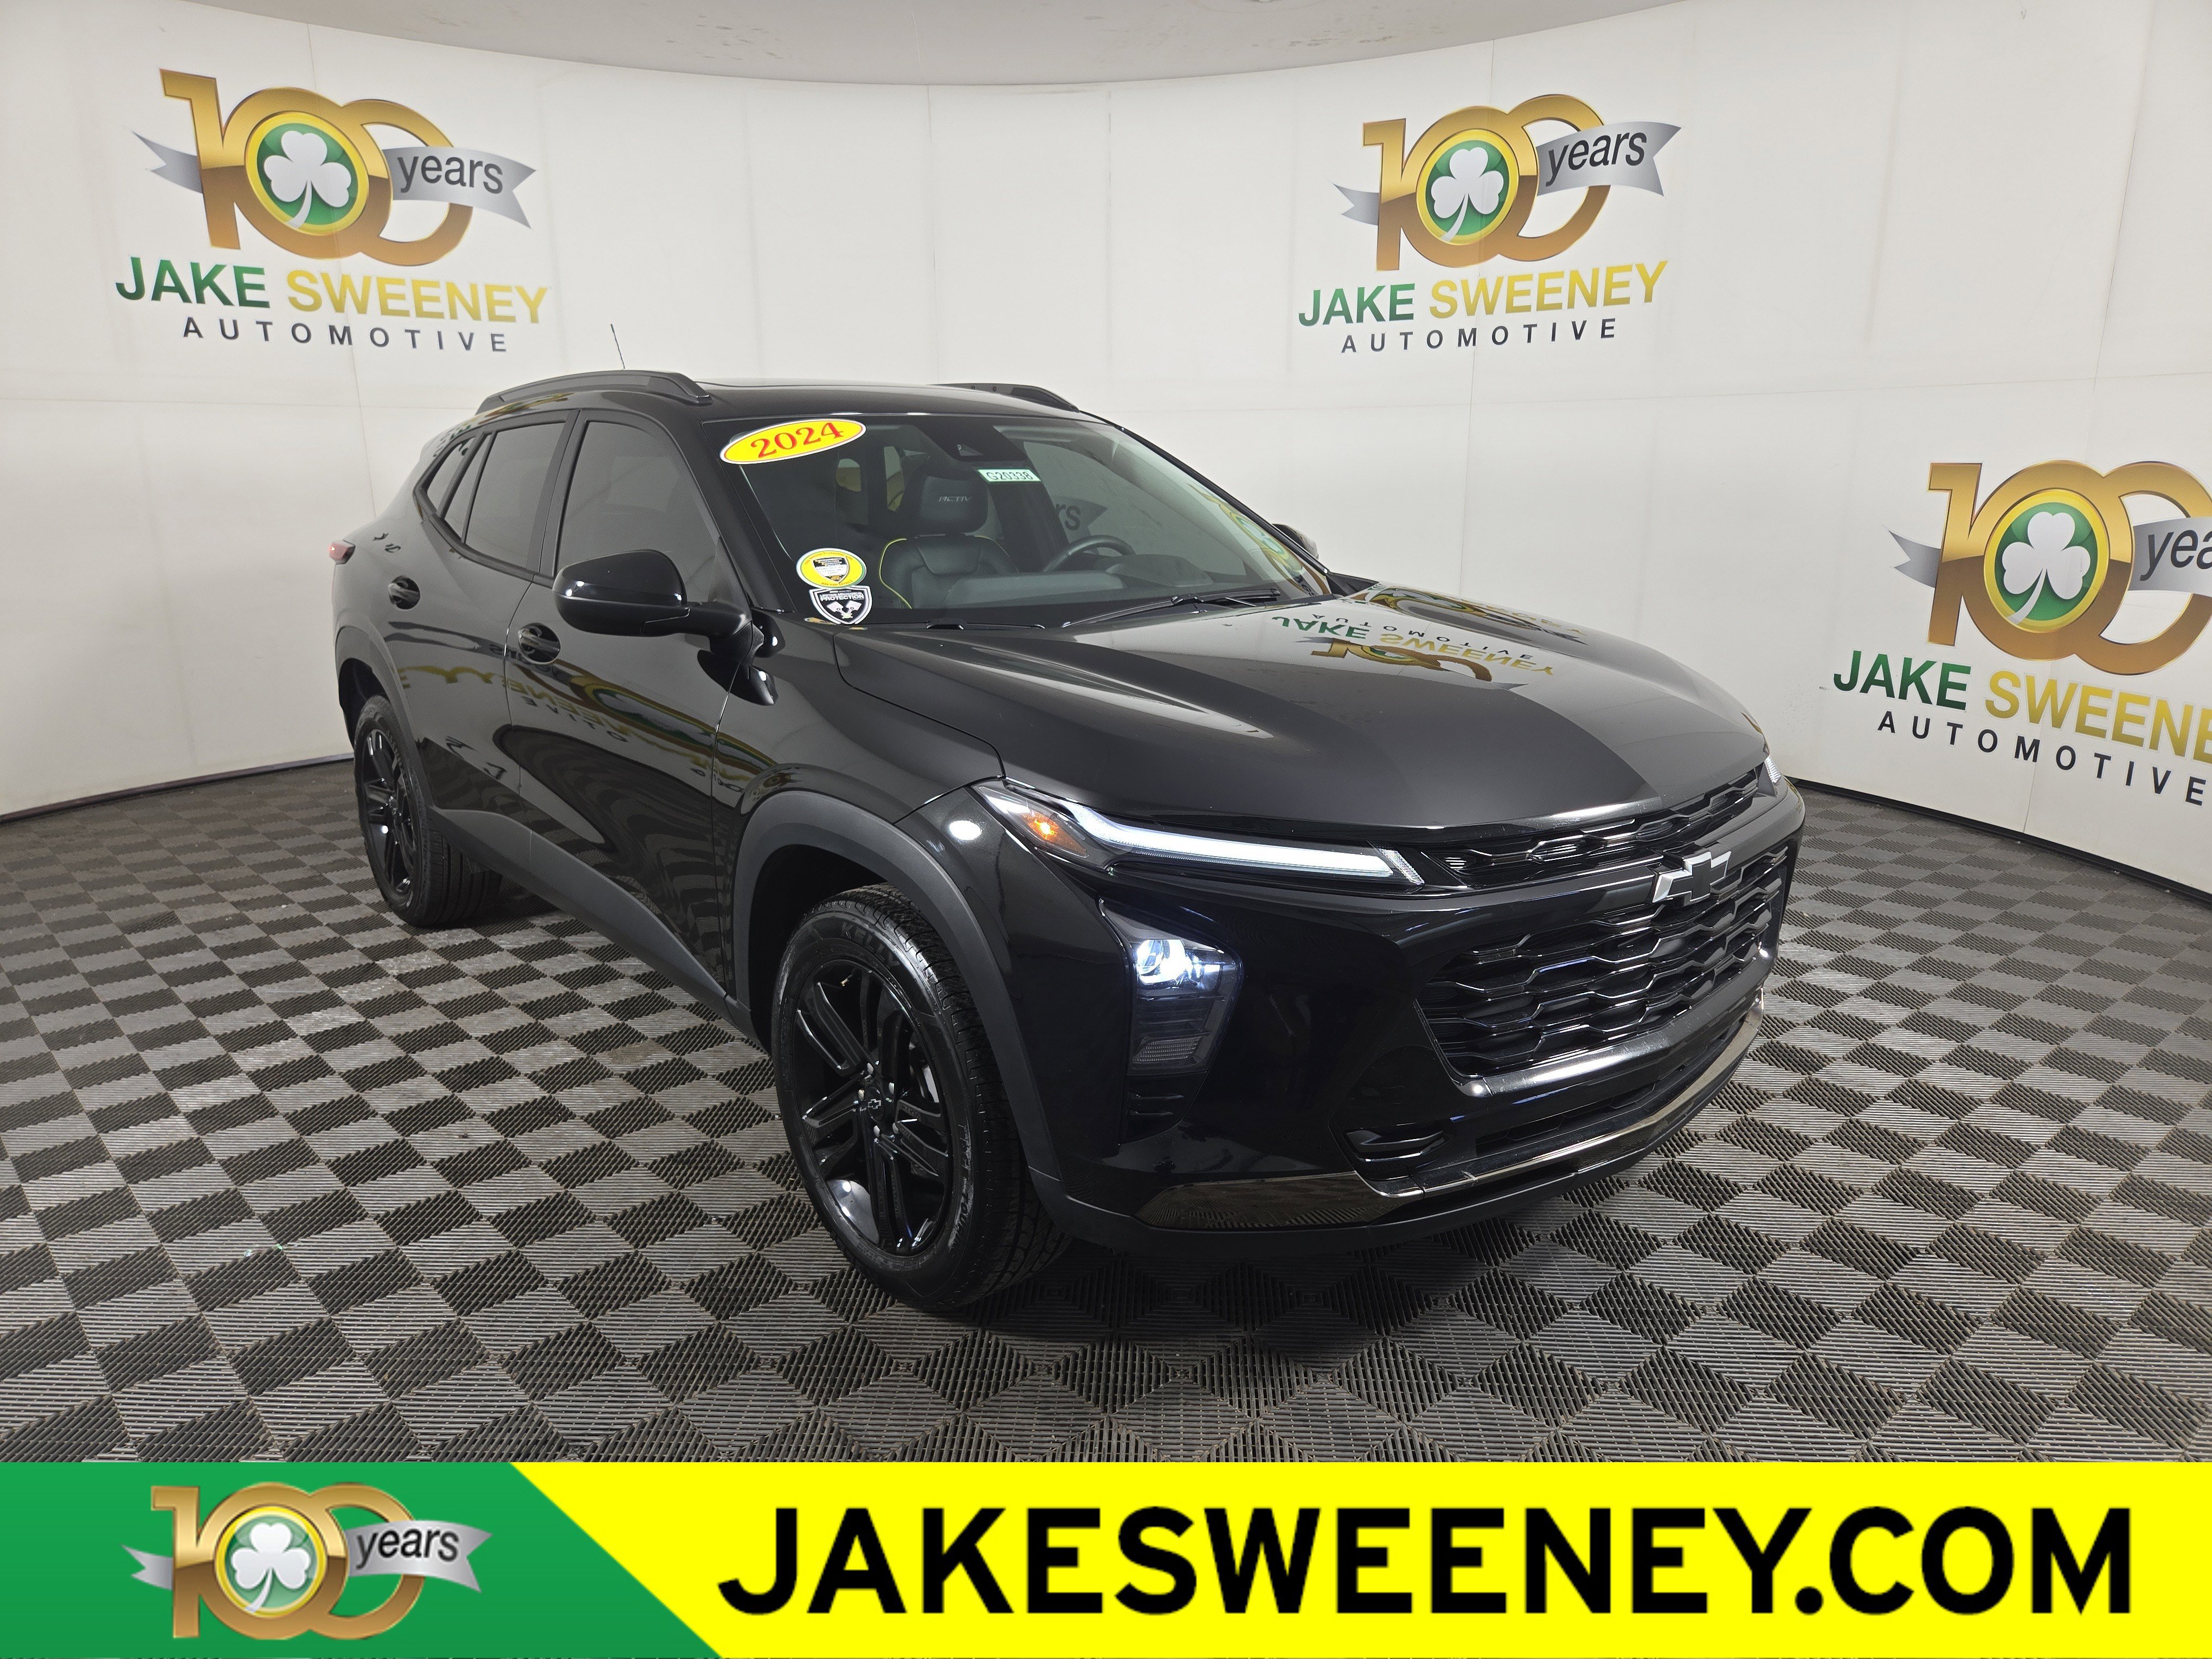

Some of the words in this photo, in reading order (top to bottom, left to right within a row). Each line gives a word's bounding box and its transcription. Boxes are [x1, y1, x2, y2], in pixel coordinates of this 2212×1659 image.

[397, 154, 504, 194] years
[1546, 131, 1648, 187] years
[115, 257, 270, 308] JAKE
[287, 269, 549, 324] SWEENEY
[1299, 283, 1415, 326] JAKE
[1430, 260, 1668, 319] SWEENEY
[183, 317, 507, 353] AUTOMOTIVE
[1341, 318, 1616, 353] AUTOMOTIVE
[751, 422, 844, 458] 2024
[986, 471, 1033, 480] G20338
[1833, 650, 1971, 710] JAKE
[1877, 711, 2207, 806] AUTOMOTIVE
[841, 921, 901, 970] KELLY
